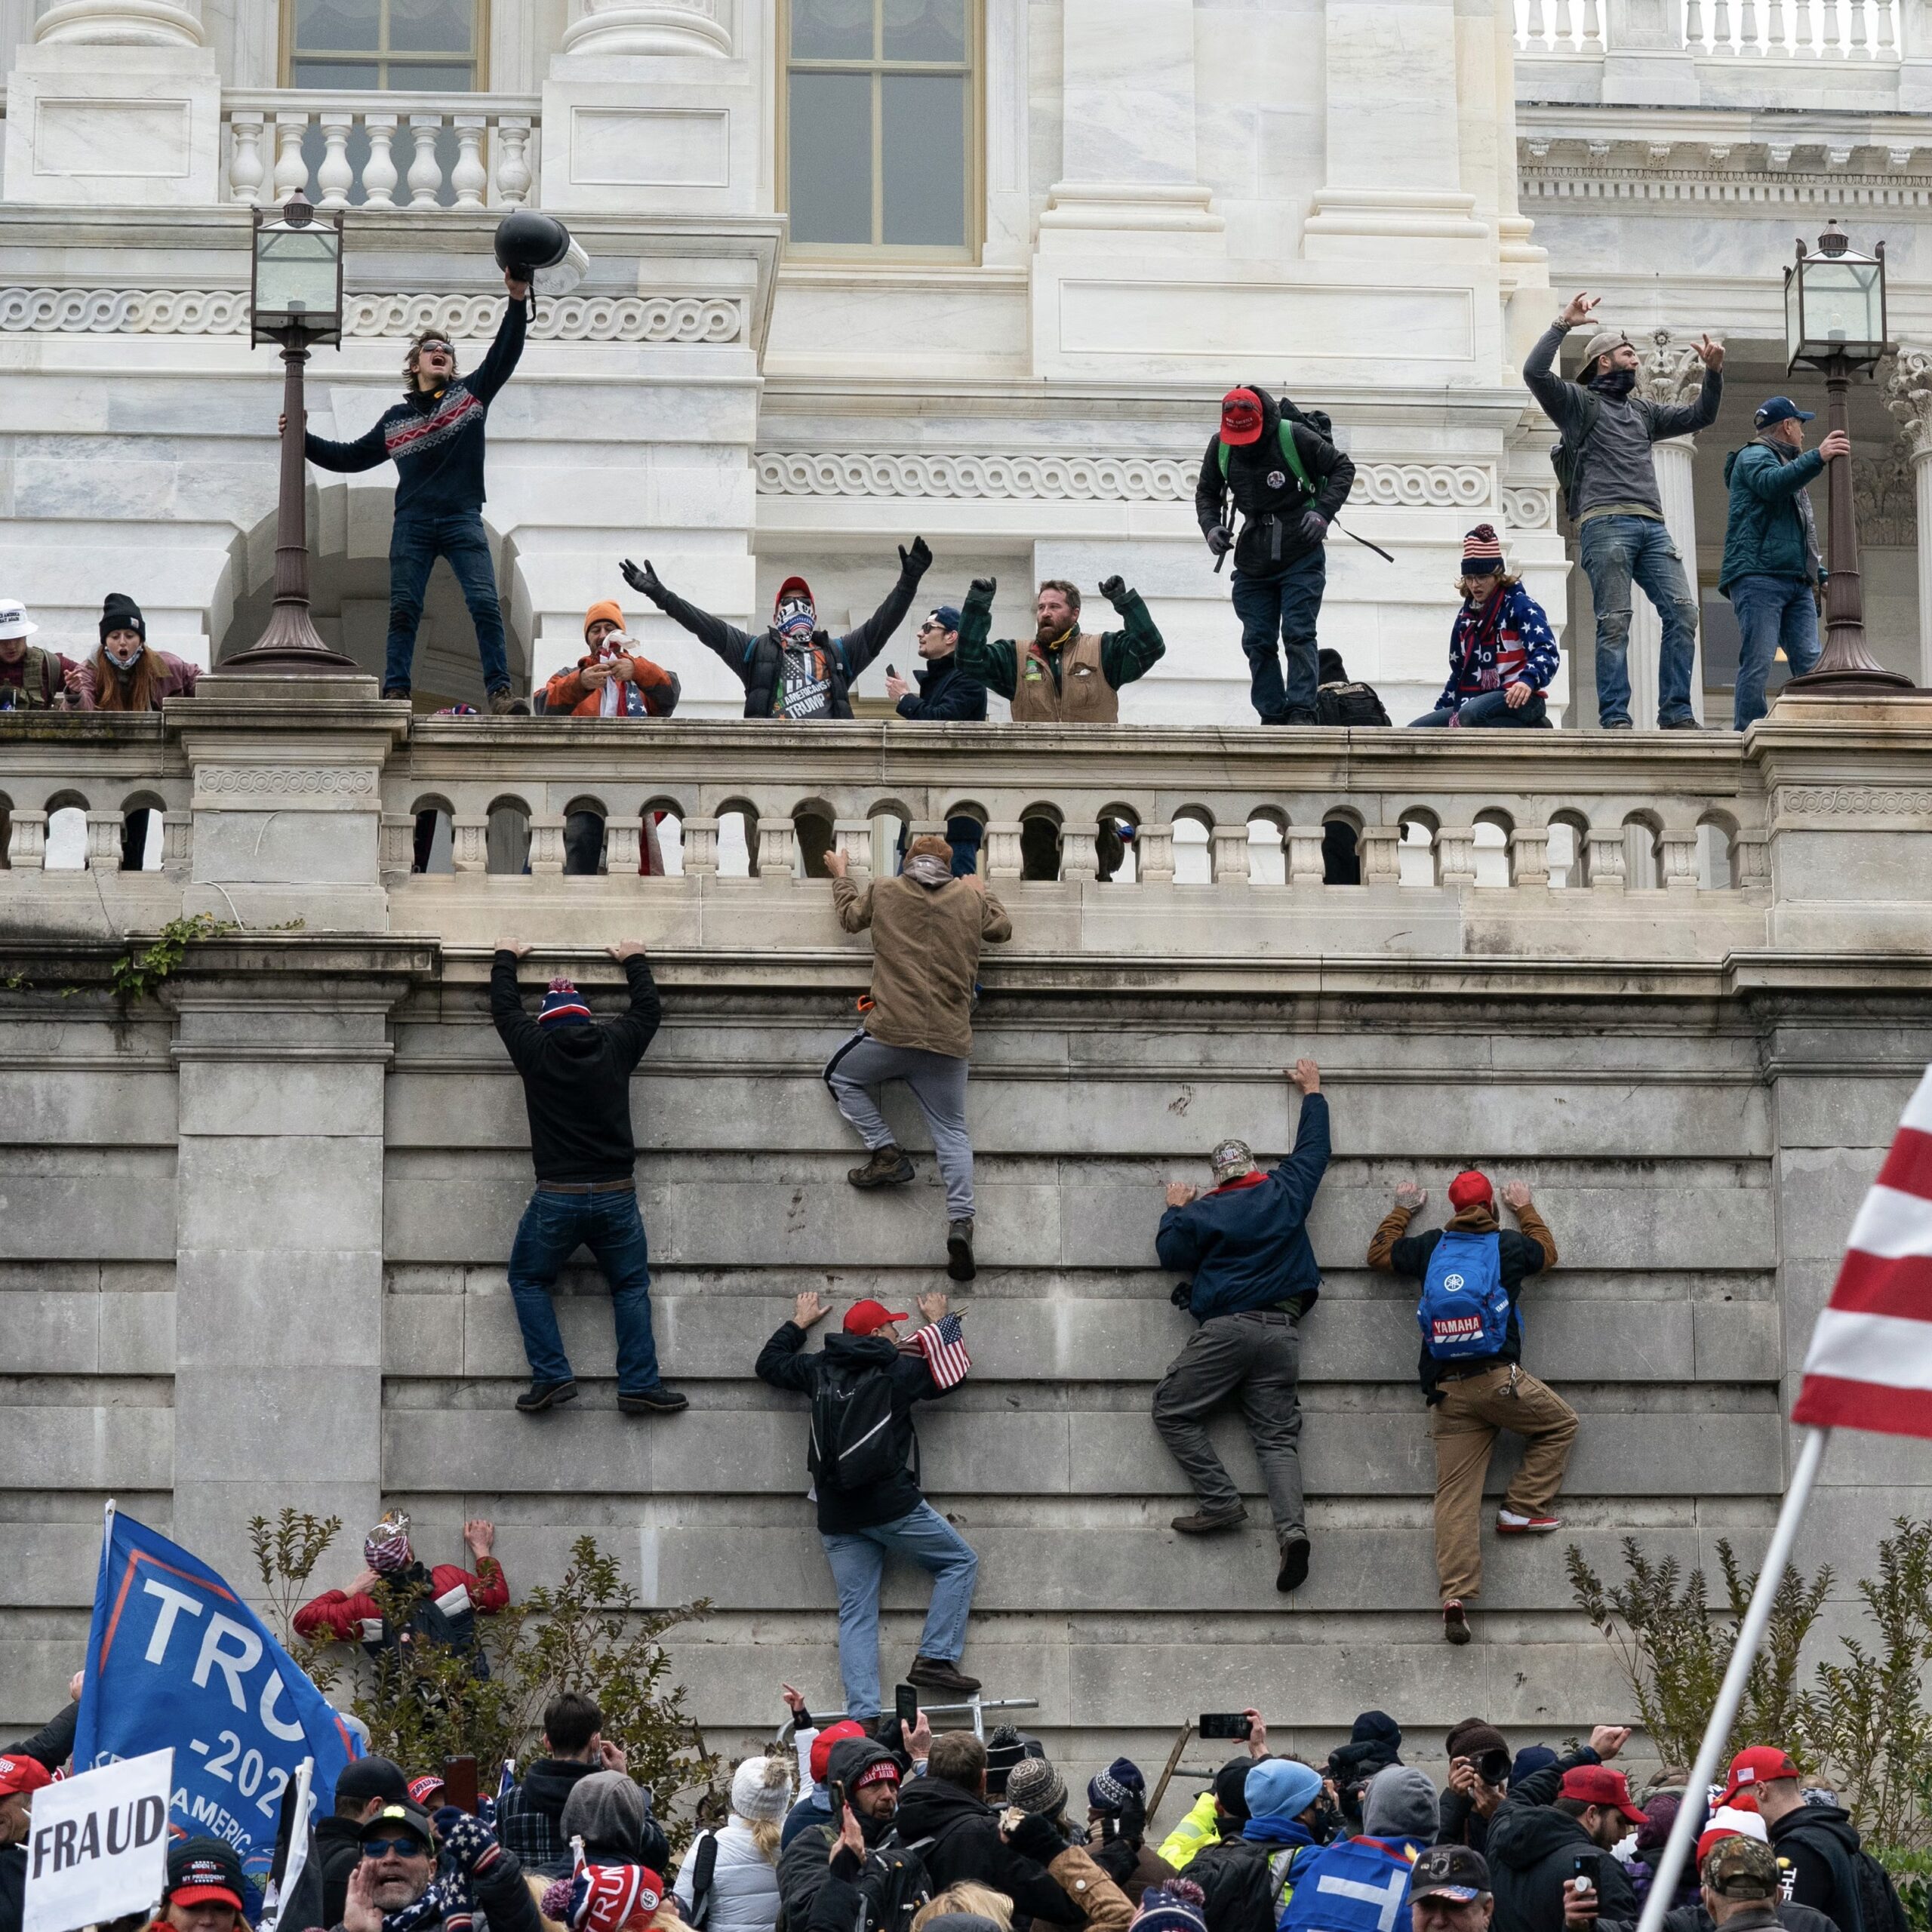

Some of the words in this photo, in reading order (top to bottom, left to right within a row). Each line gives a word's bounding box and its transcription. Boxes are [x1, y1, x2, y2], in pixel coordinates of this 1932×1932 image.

[784, 681, 828, 706] AMERICANS
[786, 693, 825, 720] TRUMP
[1434, 1317, 1480, 1334] YAMAHA
[143, 1578, 306, 1742] TRU
[872, 1763, 896, 1773] AMERICA
[878, 1770, 894, 1779] AGAIN
[169, 1787, 251, 1856] AMERIC
[32, 1795, 165, 1880] FRAUD
